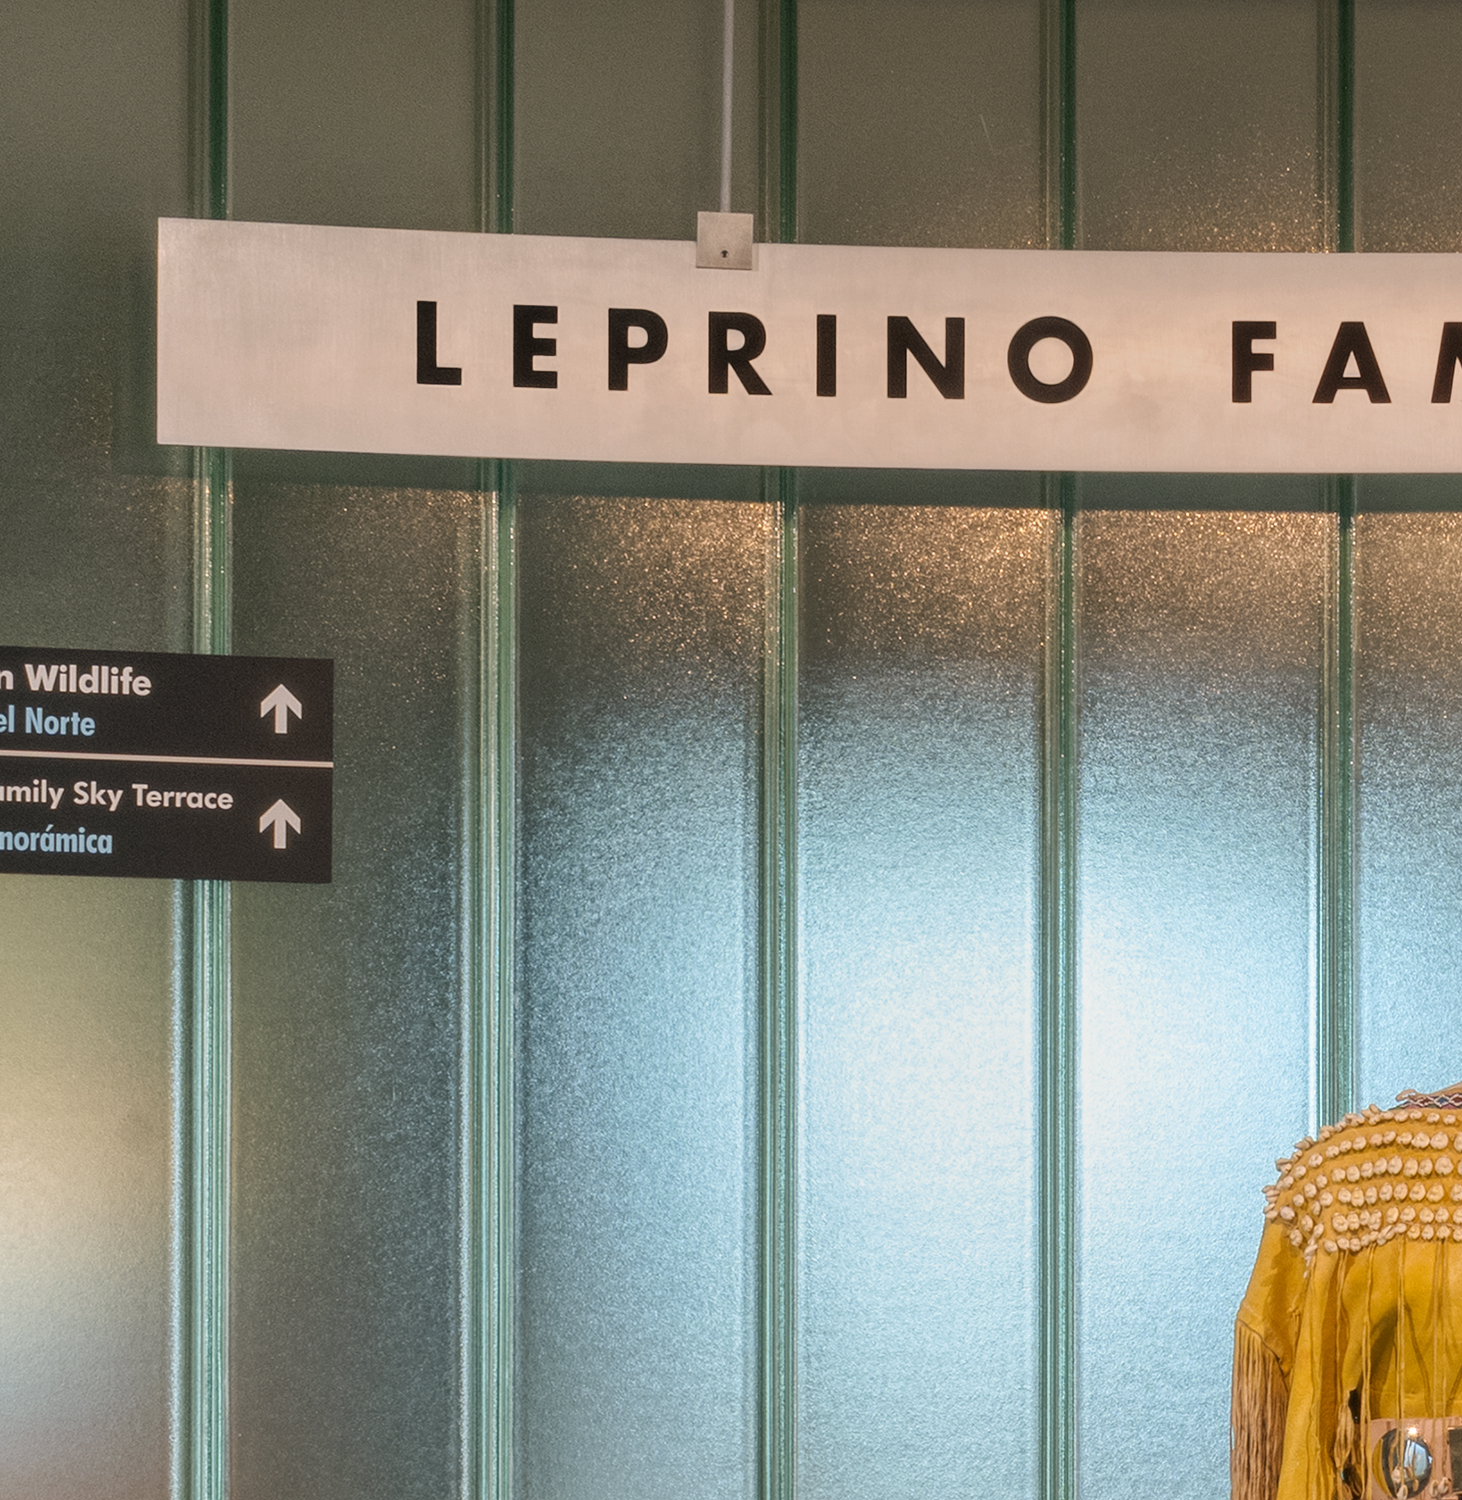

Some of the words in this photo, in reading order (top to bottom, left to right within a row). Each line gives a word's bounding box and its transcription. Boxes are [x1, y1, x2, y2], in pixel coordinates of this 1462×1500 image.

[417, 301, 1093, 403] LEPRINO
[24, 664, 152, 696] Wildlife
[25, 707, 96, 736] Norte
[0, 779, 64, 809] mily
[73, 781, 123, 811] Sky
[132, 784, 234, 809] Terrace
